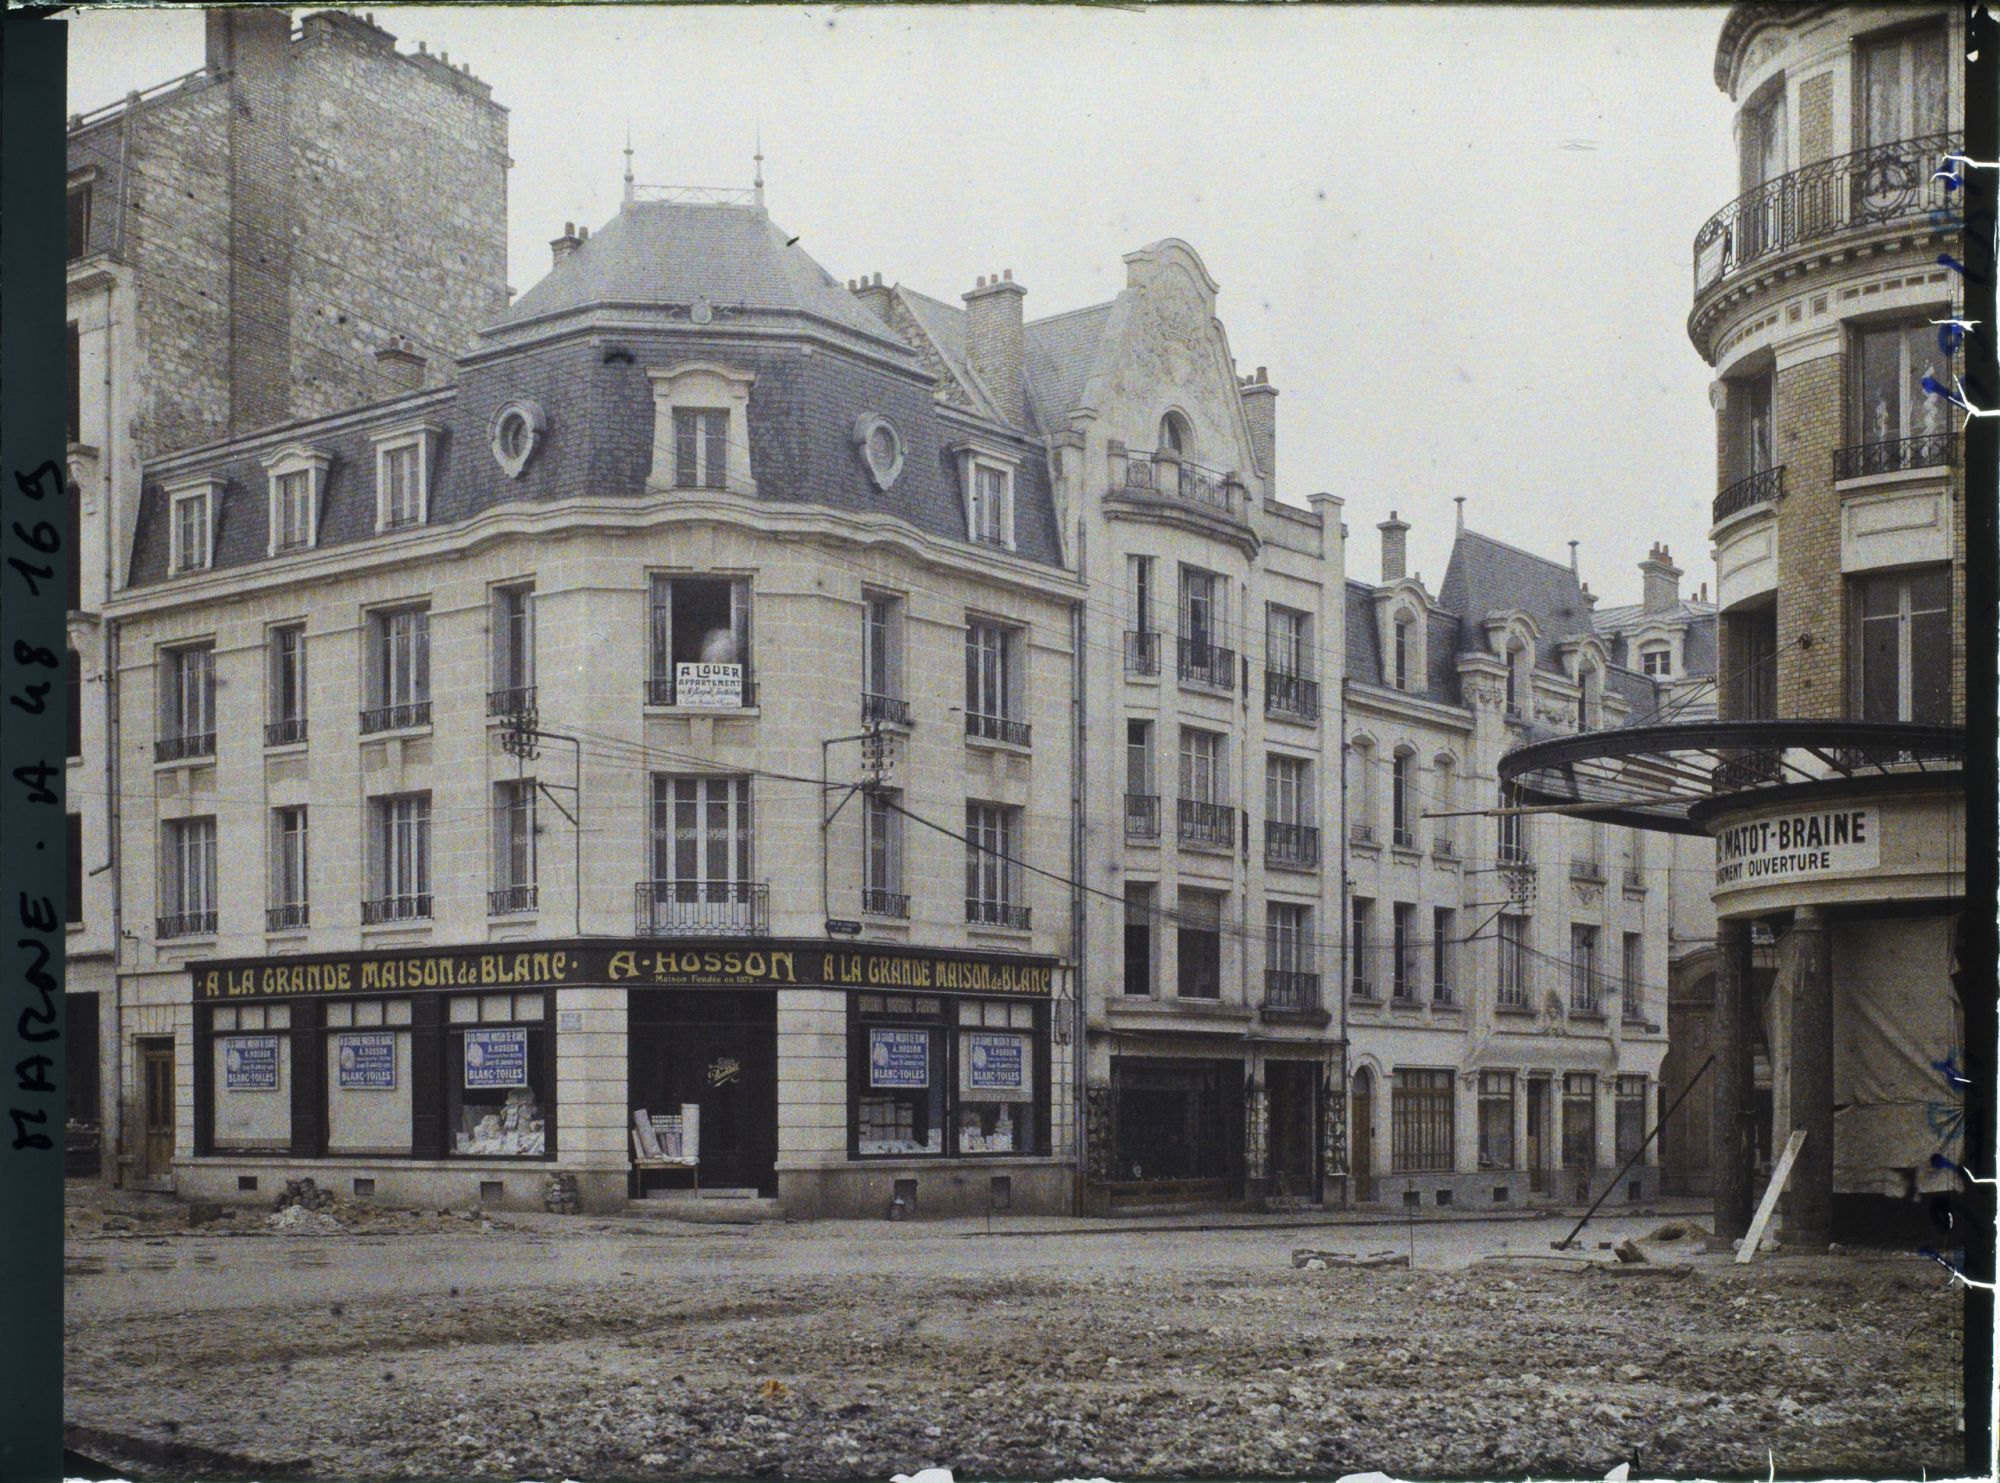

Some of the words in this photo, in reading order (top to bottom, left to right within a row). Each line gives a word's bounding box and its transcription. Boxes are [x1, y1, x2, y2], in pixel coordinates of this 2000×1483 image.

[681, 667, 690, 676] A
[696, 665, 740, 679] LOUER
[1725, 811, 1866, 861] MATOT-BRAINE
[1749, 852, 1831, 878] OUVERTURE
[206, 970, 219, 997] A
[228, 968, 255, 995] LA
[262, 962, 351, 994] GRANDE
[361, 957, 454, 989] MAISON
[457, 961, 477, 985] de
[480, 951, 567, 984] BLANC
[655, 975, 687, 983] Maison
[823, 953, 835, 981] A
[841, 953, 863, 982] LA
[869, 955, 931, 987] GRANDE
[936, 960, 990, 990] MAISON
[990, 972, 1001, 990] de
[1002, 965, 1050, 993] BLANC
[12, 892, 60, 1151] MARNE
